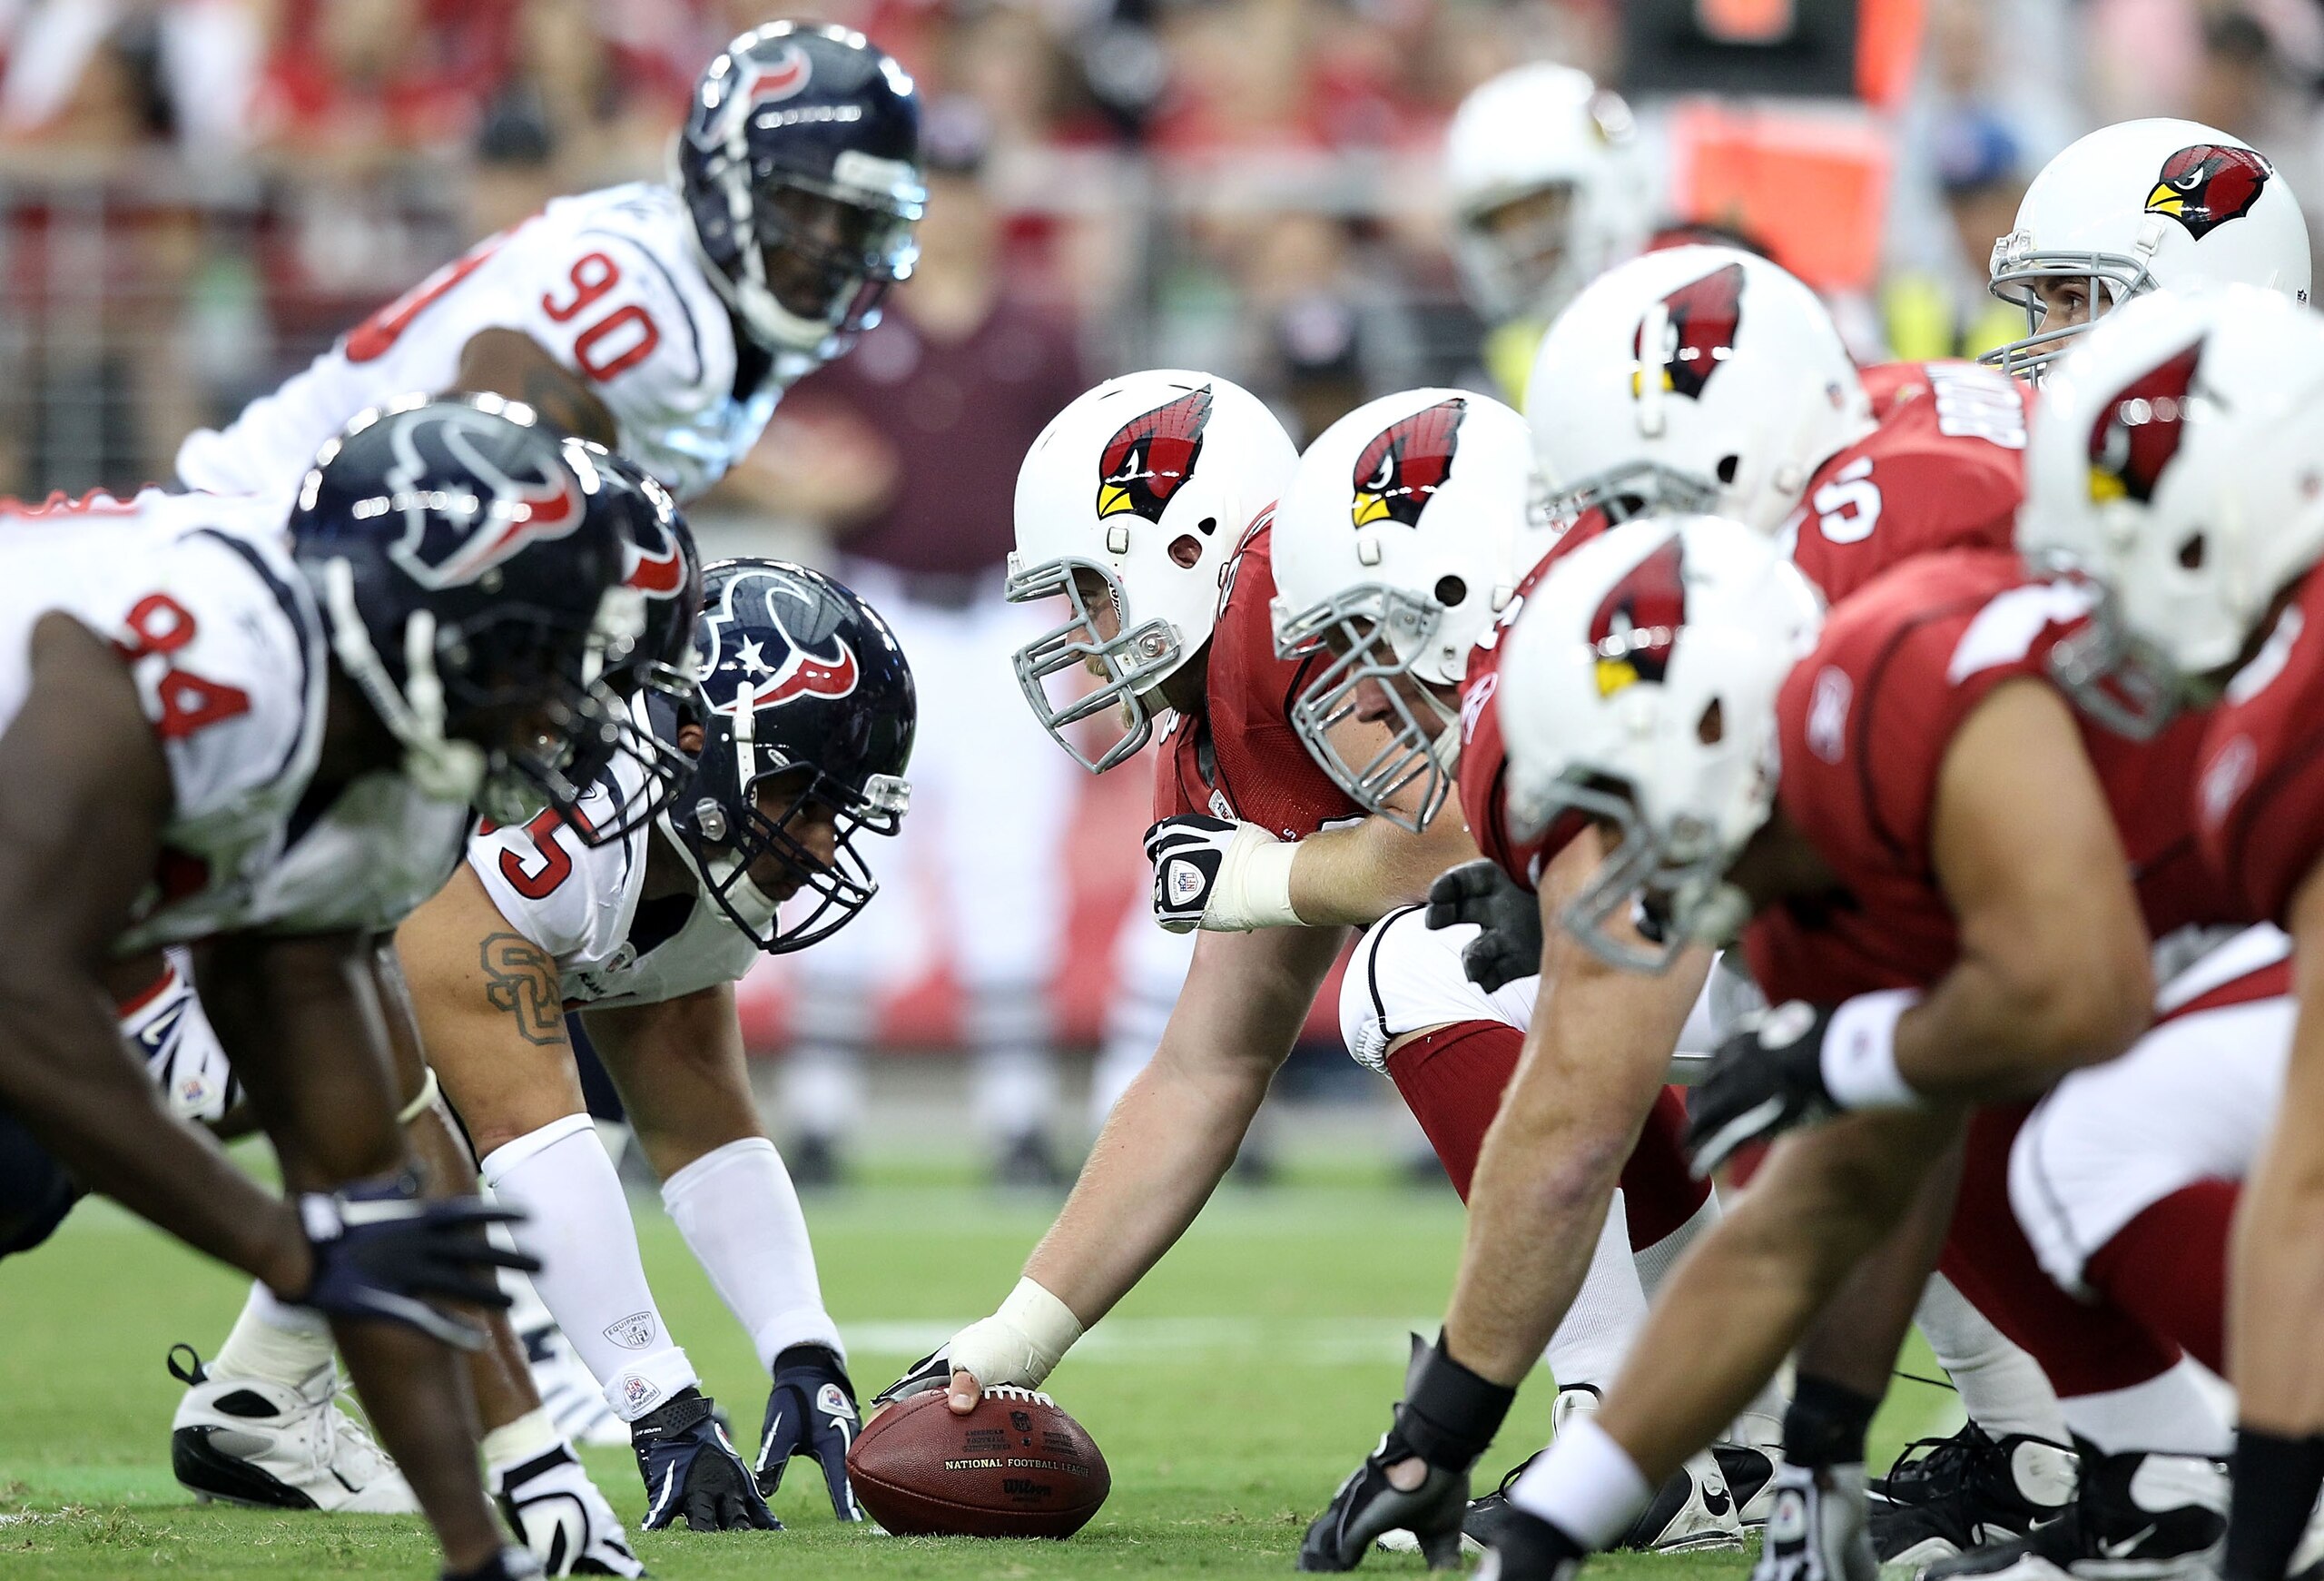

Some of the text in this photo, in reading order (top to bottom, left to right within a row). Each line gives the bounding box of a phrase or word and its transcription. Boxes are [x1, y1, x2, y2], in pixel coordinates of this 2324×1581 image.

[541, 252, 660, 382] 90
[1779, 456, 1885, 550] 5
[111, 595, 251, 739] 94
[479, 801, 604, 900] 5
[1186, 874, 1196, 890] NFL
[608, 1313, 650, 1336] EQUIPMENT
[627, 1329, 649, 1346] NFL
[625, 1379, 643, 1396] NFL
[945, 1458, 1089, 1477] NATIONAL FOOTBALL LEAGUE
[1003, 1478, 1052, 1496] Wilson
